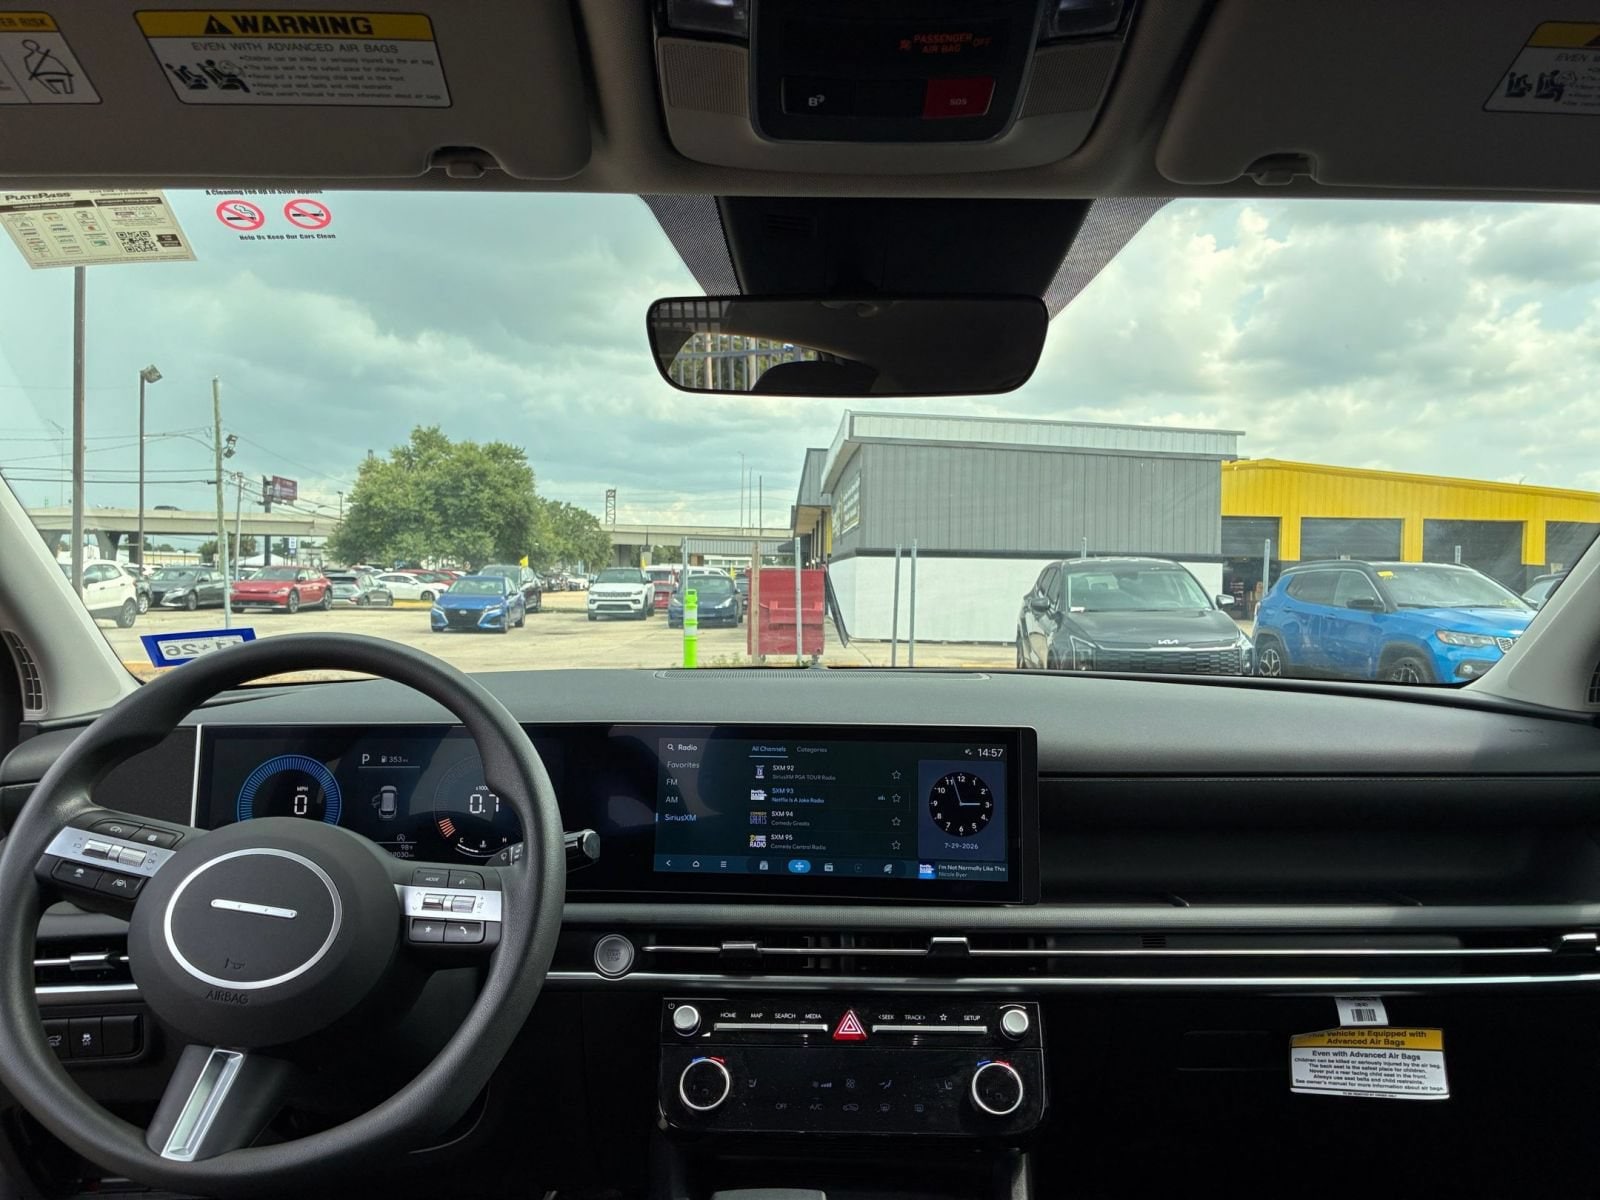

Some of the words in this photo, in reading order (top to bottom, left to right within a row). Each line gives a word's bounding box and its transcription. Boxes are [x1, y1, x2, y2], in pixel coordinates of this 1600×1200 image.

[232, 16, 373, 35] WARNING
[912, 32, 974, 42] PASSENGER
[974, 36, 992, 47] OFF
[192, 42, 226, 51] EVEN
[232, 42, 263, 52] WITH
[268, 43, 334, 52] ADVANCED
[340, 44, 361, 52] AIR
[364, 45, 398, 54] BAGS
[941, 44, 960, 53] BAG
[978, 748, 1004, 757] 14:57
[362, 754, 370, 765] P
[294, 795, 308, 815] 0
[470, 794, 500, 814] 0.7
[206, 990, 248, 1004] AIRBAG
[1384, 1039, 1405, 1047] Bags
[1401, 1053, 1421, 1061] Bags
